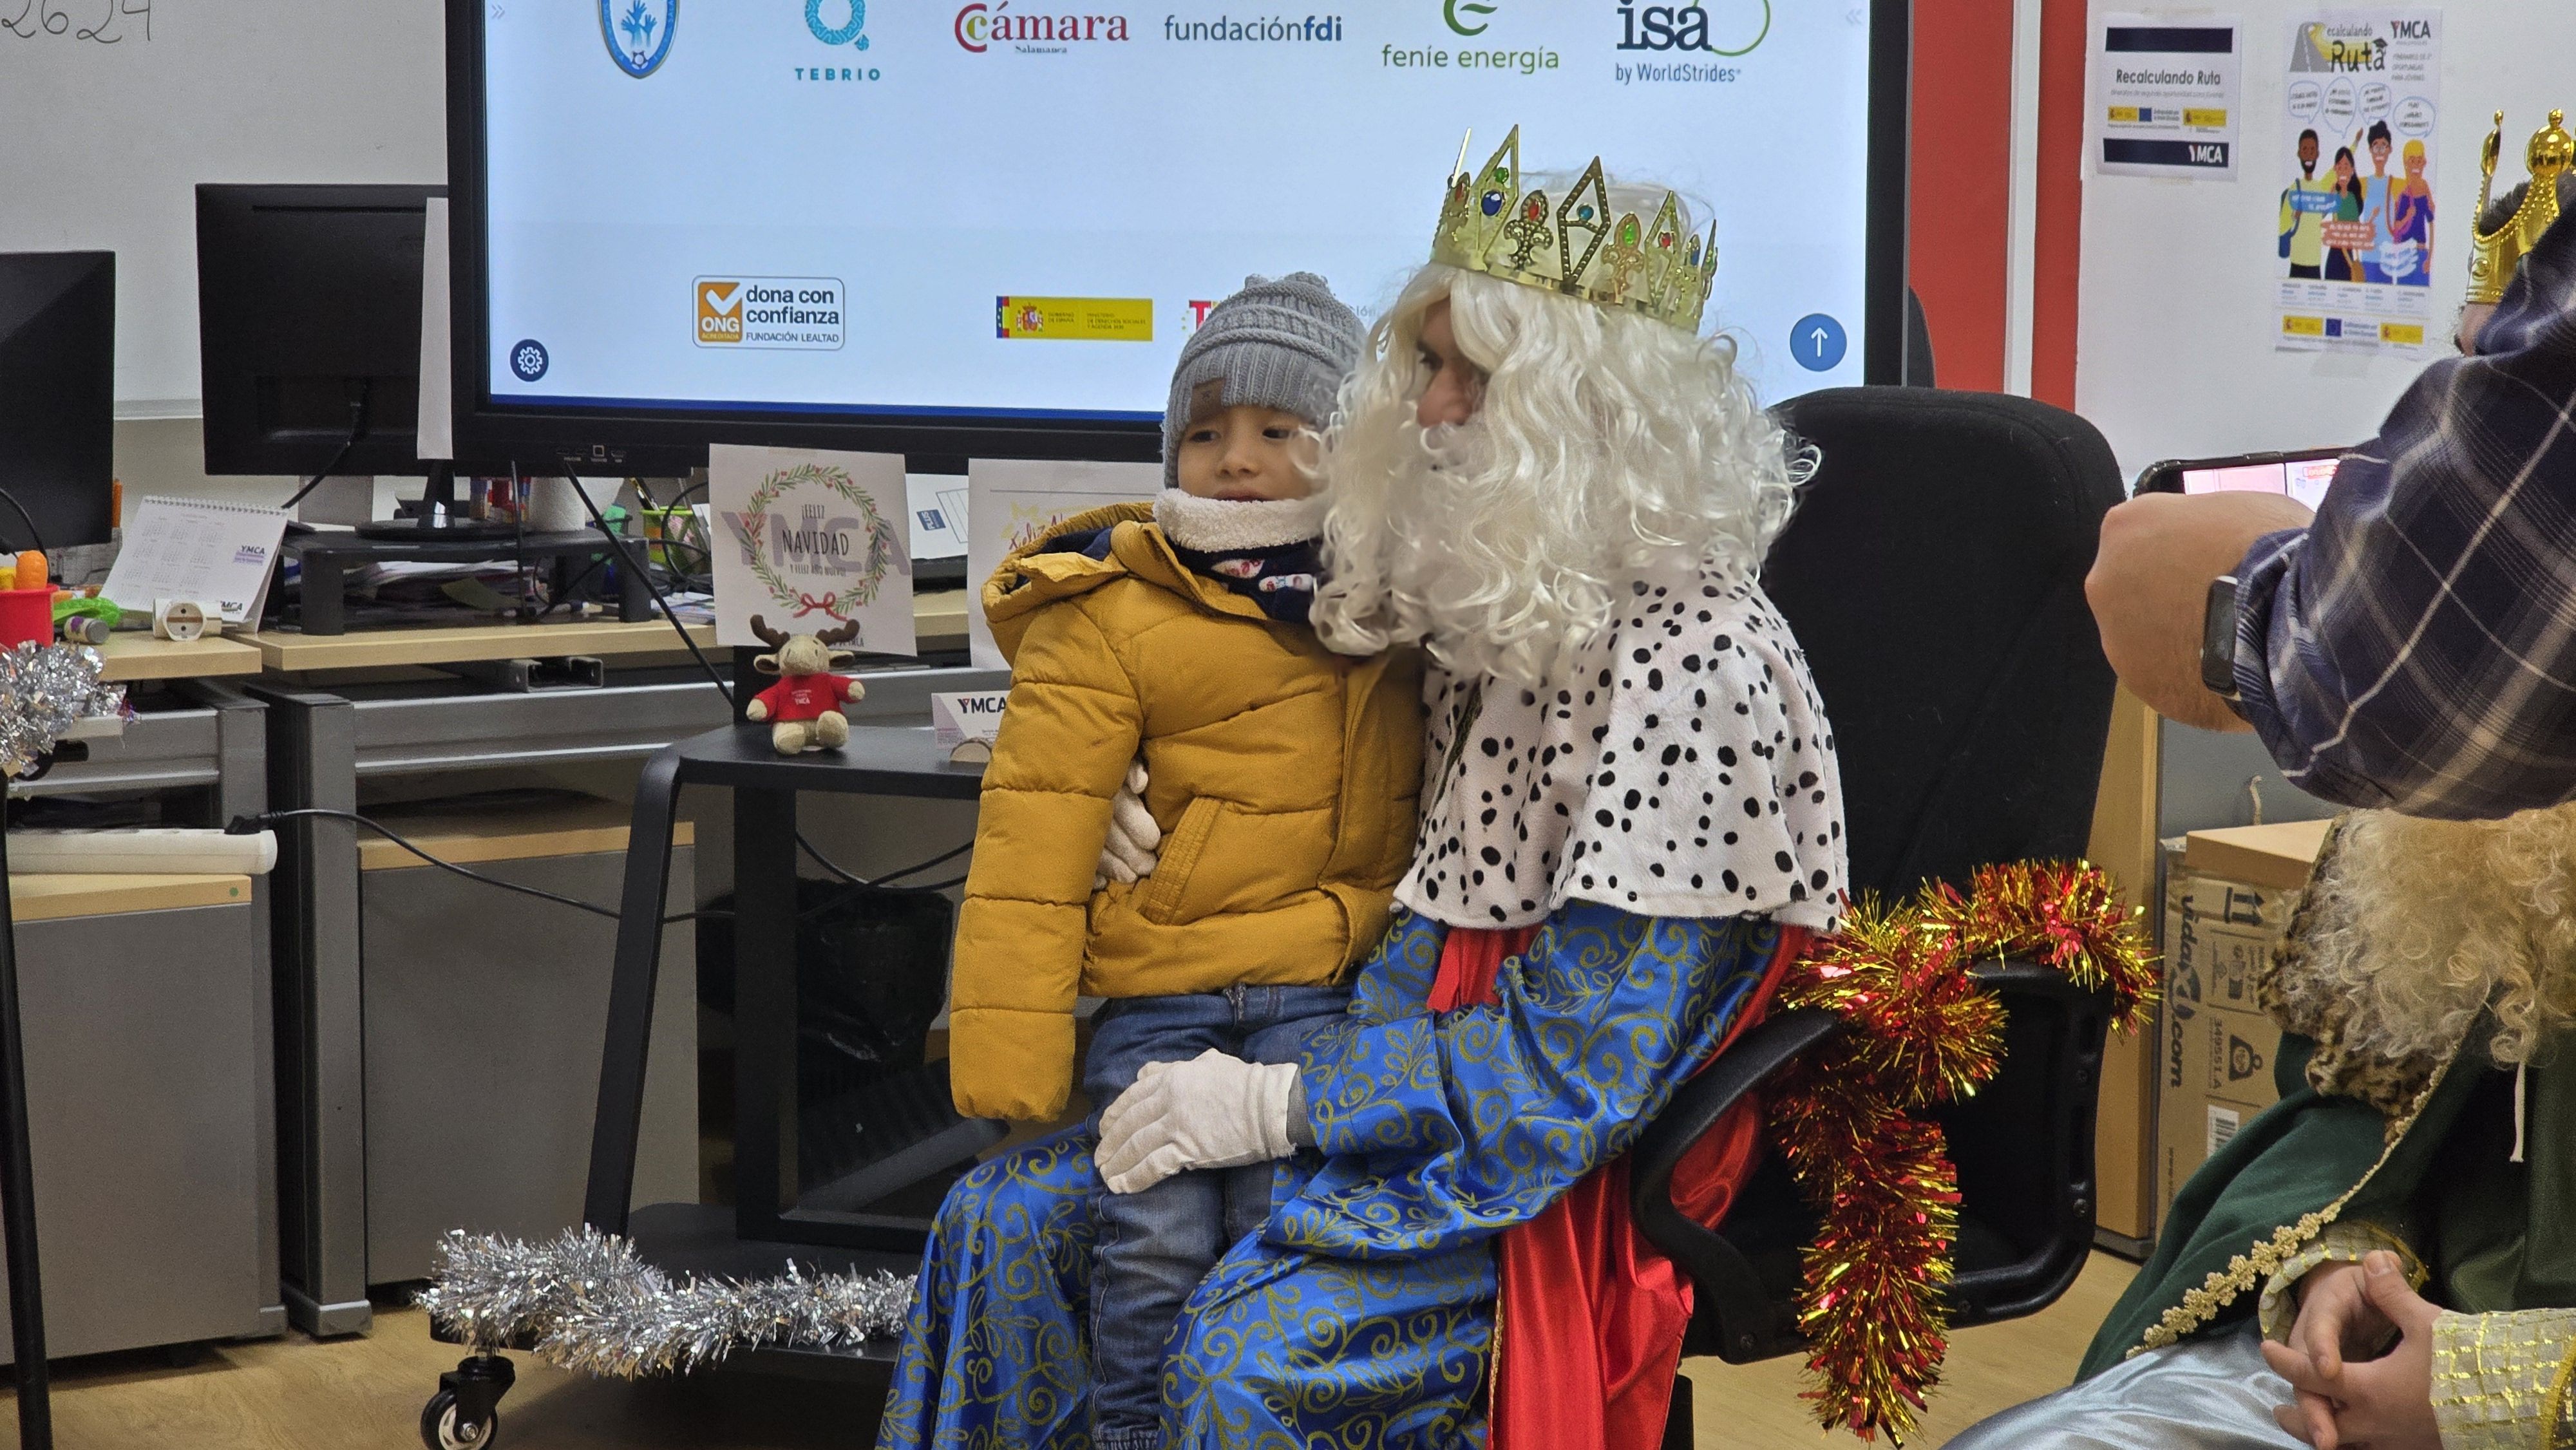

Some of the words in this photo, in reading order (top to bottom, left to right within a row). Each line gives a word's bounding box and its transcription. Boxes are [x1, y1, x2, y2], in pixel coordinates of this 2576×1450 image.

[1617, 0, 1712, 51] isa
[2391, 21, 2431, 39] YMCA
[1015, 45, 1067, 53] Salamanca
[2331, 40, 2387, 73] Ruta
[1458, 46, 1558, 75] energía
[795, 68, 880, 81] TEBRIO
[1616, 63, 1632, 85] by
[2116, 68, 2194, 85] Recalculando
[2197, 70, 2221, 85] Ruta
[2189, 145, 2222, 163] YMCA
[746, 285, 793, 304] dona
[799, 290, 834, 303] con
[701, 316, 740, 333] ONG
[746, 306, 839, 325] confianza
[746, 331, 798, 342] FUNDACIÓN
[801, 334, 839, 343] LEALTAD
[922, 511, 934, 530] PLUS
[242, 545, 265, 554] YMCA
[782, 529, 849, 556] NAVIDAD
[958, 697, 1006, 714] YMCA
